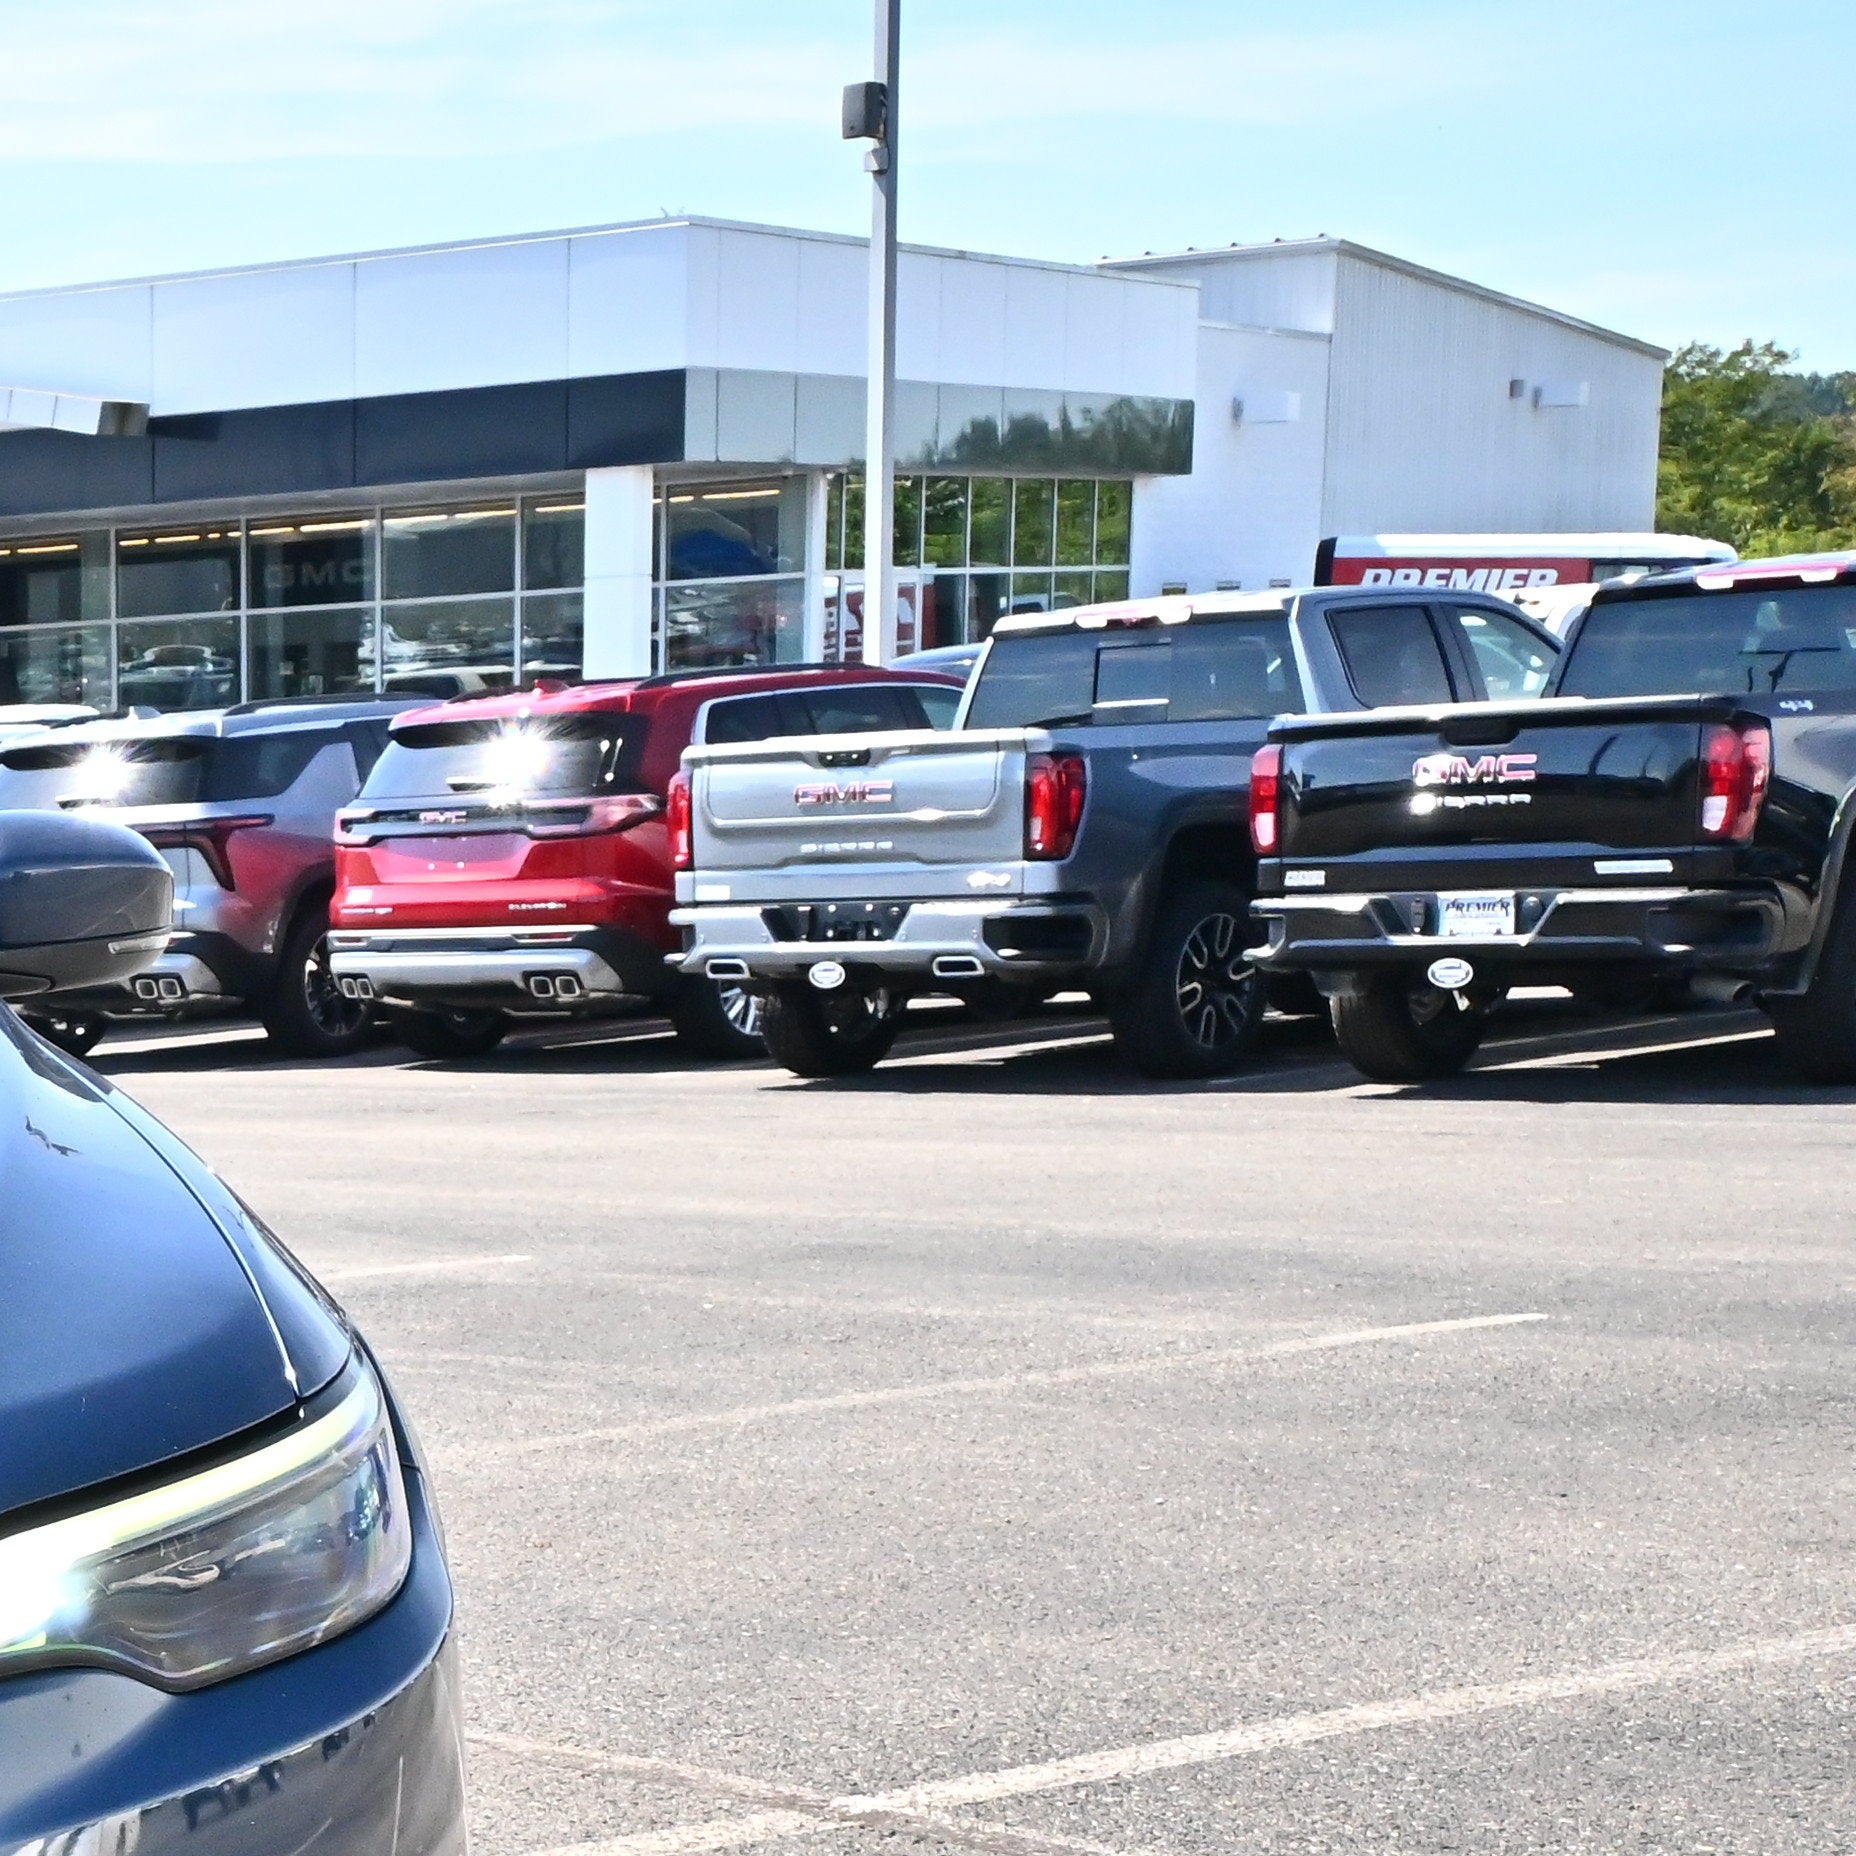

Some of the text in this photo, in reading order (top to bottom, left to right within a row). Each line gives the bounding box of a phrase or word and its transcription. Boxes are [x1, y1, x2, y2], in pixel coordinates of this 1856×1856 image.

[1361, 568, 1558, 590] PREMIER
[1412, 754, 1538, 786] GMC
[794, 780, 893, 805] GMC
[1444, 898, 1510, 917] PREMIER
